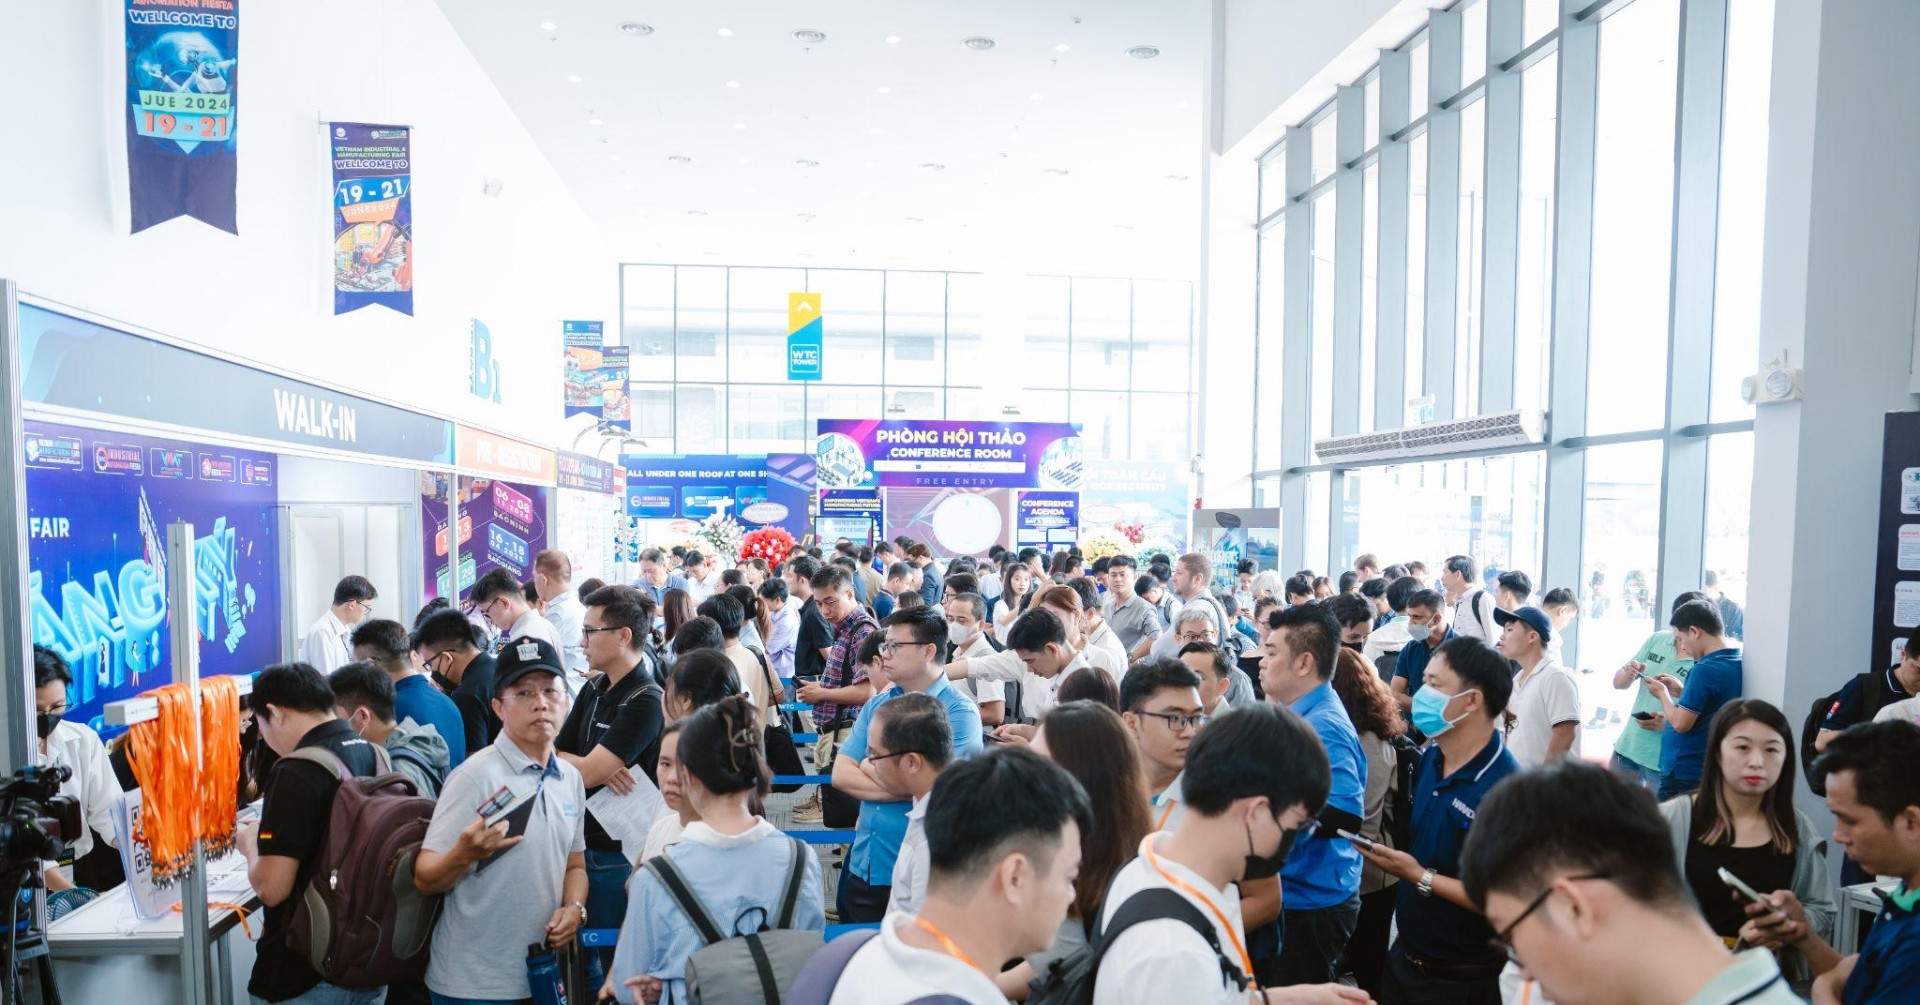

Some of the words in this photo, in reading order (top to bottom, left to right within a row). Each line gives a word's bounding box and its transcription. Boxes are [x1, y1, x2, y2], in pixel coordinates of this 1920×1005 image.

[129, 9, 213, 27] WELLCOME
[214, 16, 237, 29] TO
[143, 94, 176, 108] JUE
[185, 97, 228, 110] 2024
[144, 111, 177, 135] 19
[200, 115, 227, 137] 21
[335, 159, 392, 169] WELLCOME
[393, 159, 408, 168] TO
[340, 185, 363, 205] 19
[381, 178, 403, 199] 21
[792, 350, 817, 359] WTC
[273, 388, 357, 443] WALK-IN
[875, 427, 939, 444] PHÒNG
[943, 428, 974, 448] HỘI
[978, 426, 1027, 446] THẢO
[890, 447, 972, 459] CONFERENCE
[974, 448, 1012, 460] ROOM
[645, 470, 676, 478] UNDER
[678, 470, 697, 478] ONE
[699, 470, 723, 479] ROOF
[724, 470, 736, 478] AT
[737, 470, 756, 478] ONE
[916, 477, 948, 485] FREE
[955, 478, 996, 486] ENTRY
[495, 486, 509, 501] 06
[1021, 500, 1074, 508] CONFERENCE
[1030, 508, 1065, 516] AGENDA
[29, 517, 71, 538] FAIR
[489, 528, 502, 543] 16
[512, 541, 525, 556] 18
